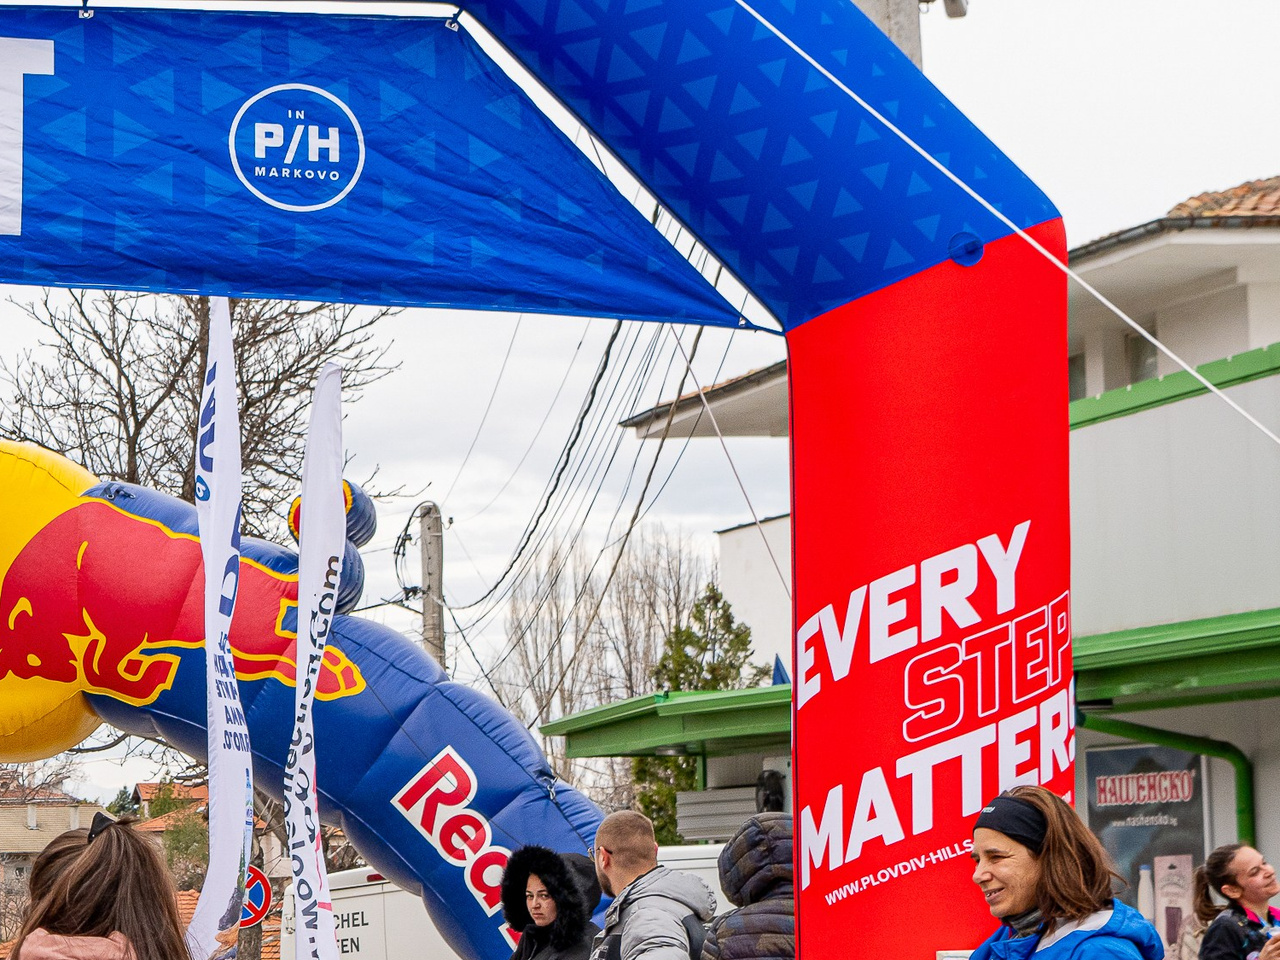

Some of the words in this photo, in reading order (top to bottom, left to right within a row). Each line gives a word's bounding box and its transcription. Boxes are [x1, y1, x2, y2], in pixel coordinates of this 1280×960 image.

[287, 109, 305, 120] IN
[253, 122, 340, 165] P/H
[254, 166, 340, 181] MARKOVO
[797, 519, 1031, 710] EVERY
[902, 590, 1071, 743] STEP
